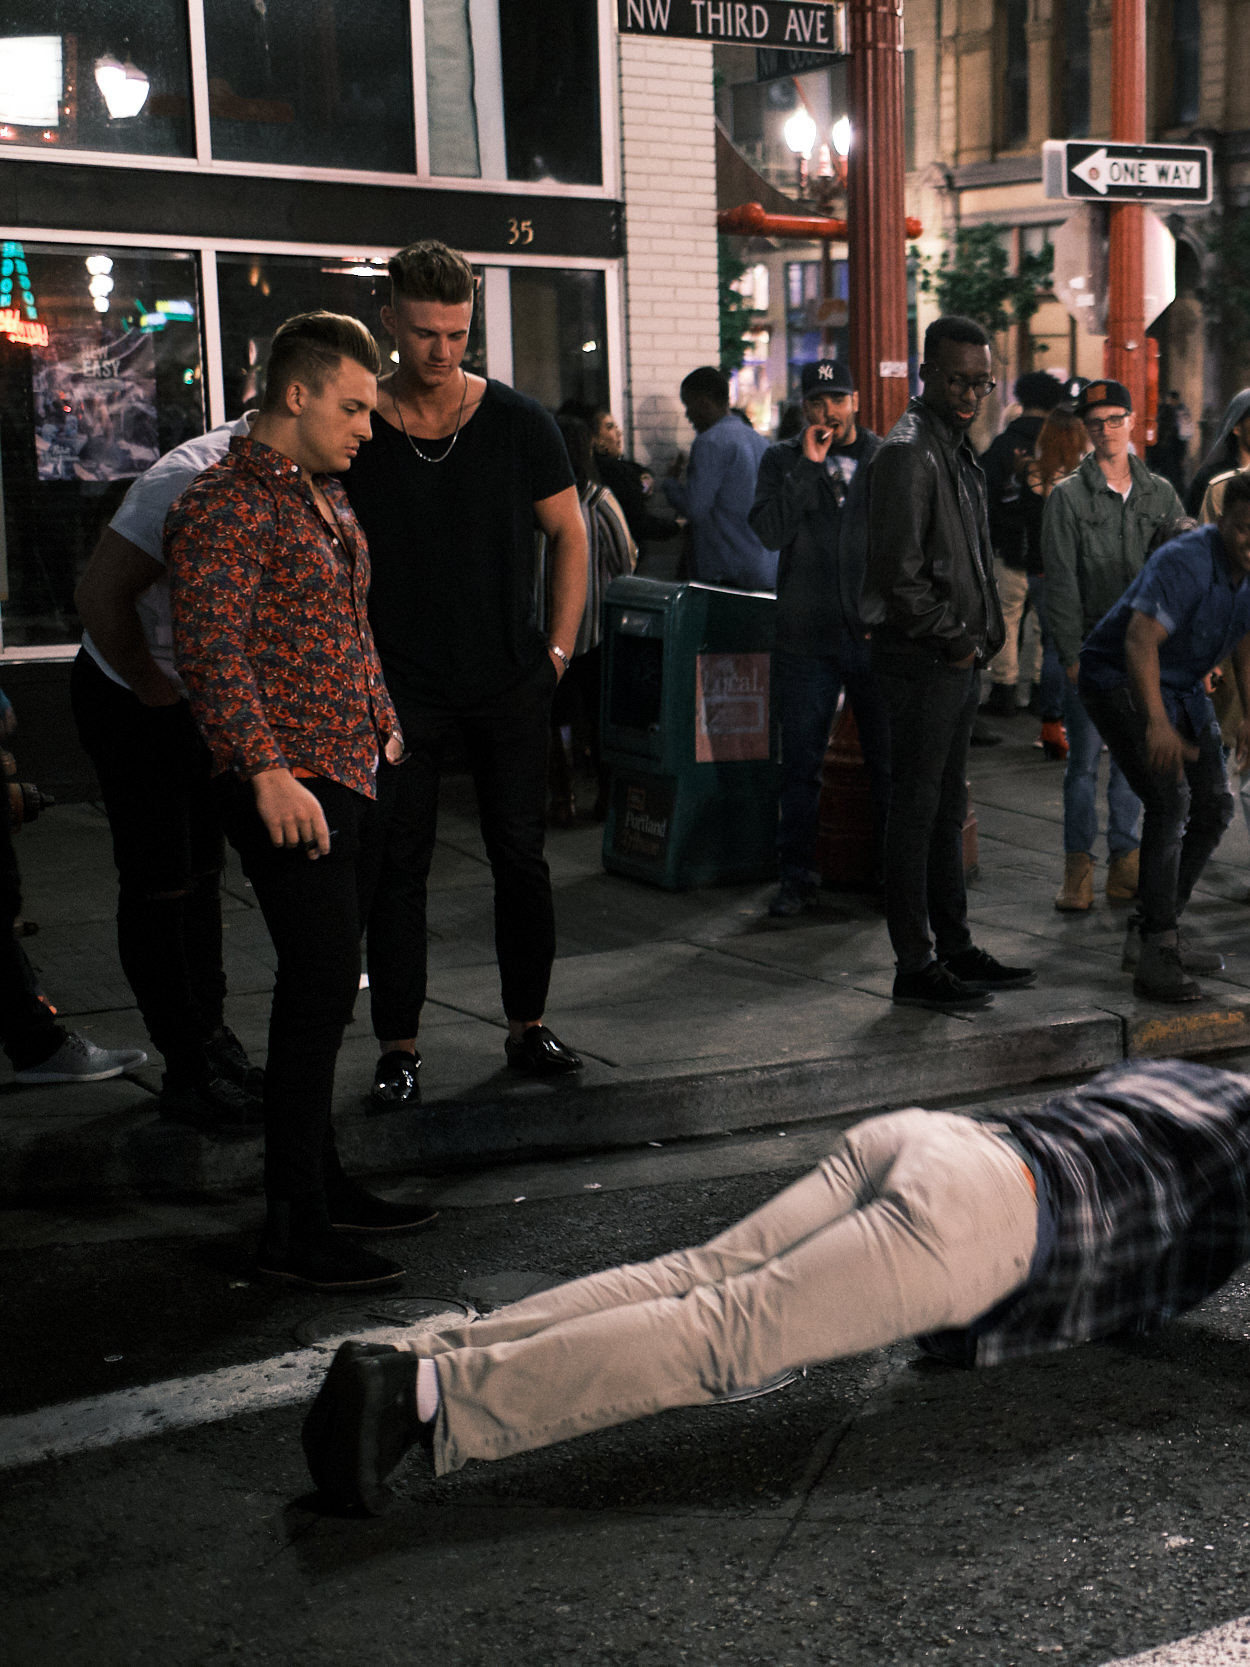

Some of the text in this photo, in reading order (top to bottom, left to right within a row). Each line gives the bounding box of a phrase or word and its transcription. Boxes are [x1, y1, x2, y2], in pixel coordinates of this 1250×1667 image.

[626, 0, 829, 44] NW THIRD AVE
[1109, 161, 1194, 185] ONE WAY
[507, 218, 534, 245] 35
[82, 359, 121, 378] EASY
[624, 809, 668, 837] Portland
